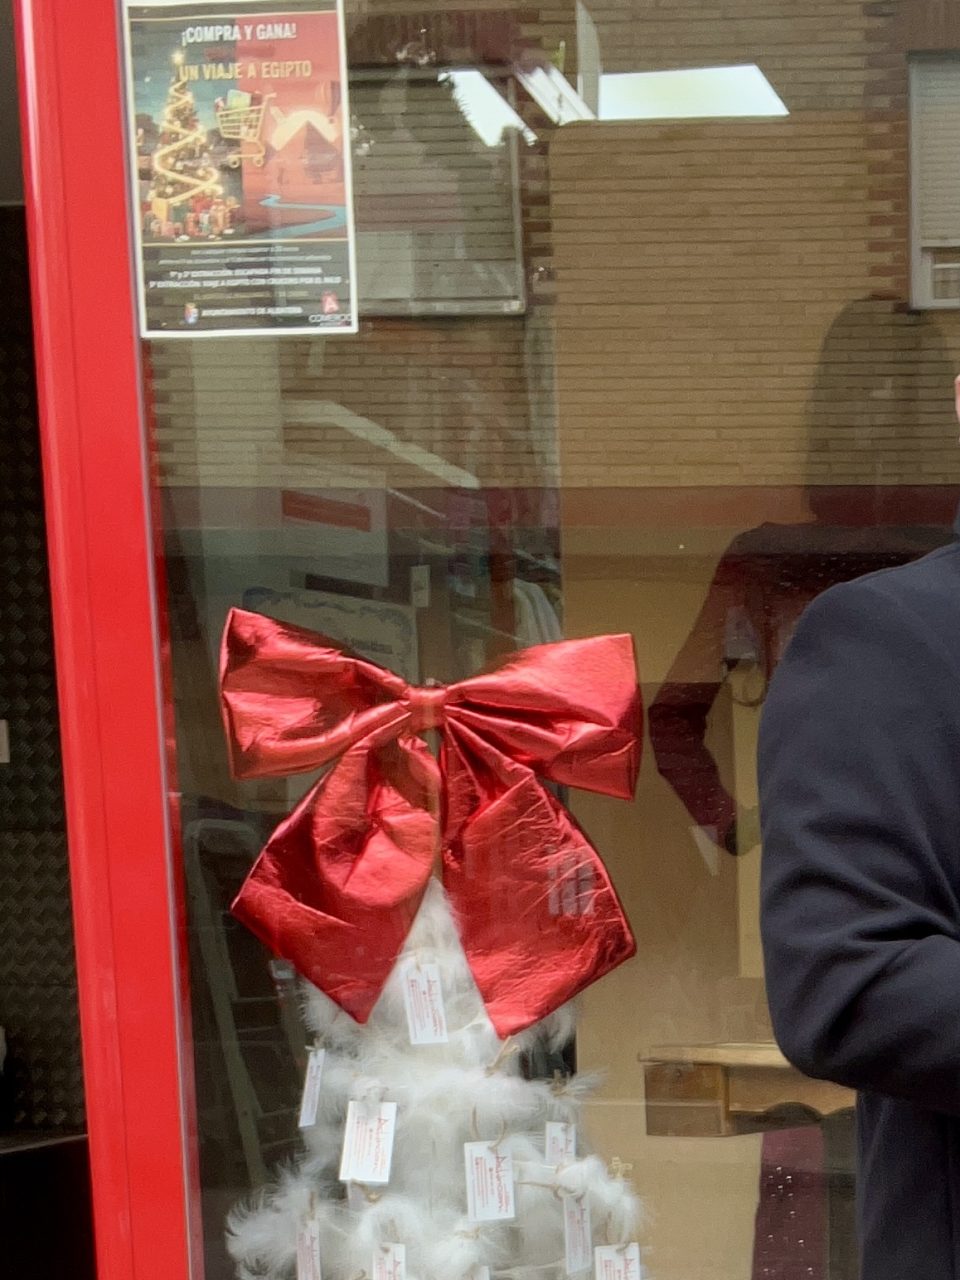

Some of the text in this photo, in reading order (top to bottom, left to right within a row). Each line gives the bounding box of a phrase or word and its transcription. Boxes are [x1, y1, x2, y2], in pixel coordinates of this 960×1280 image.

[181, 22, 297, 47] ¡COMPRA Y GANA!
[180, 59, 312, 81] UN VIAJE A EGIPTO
